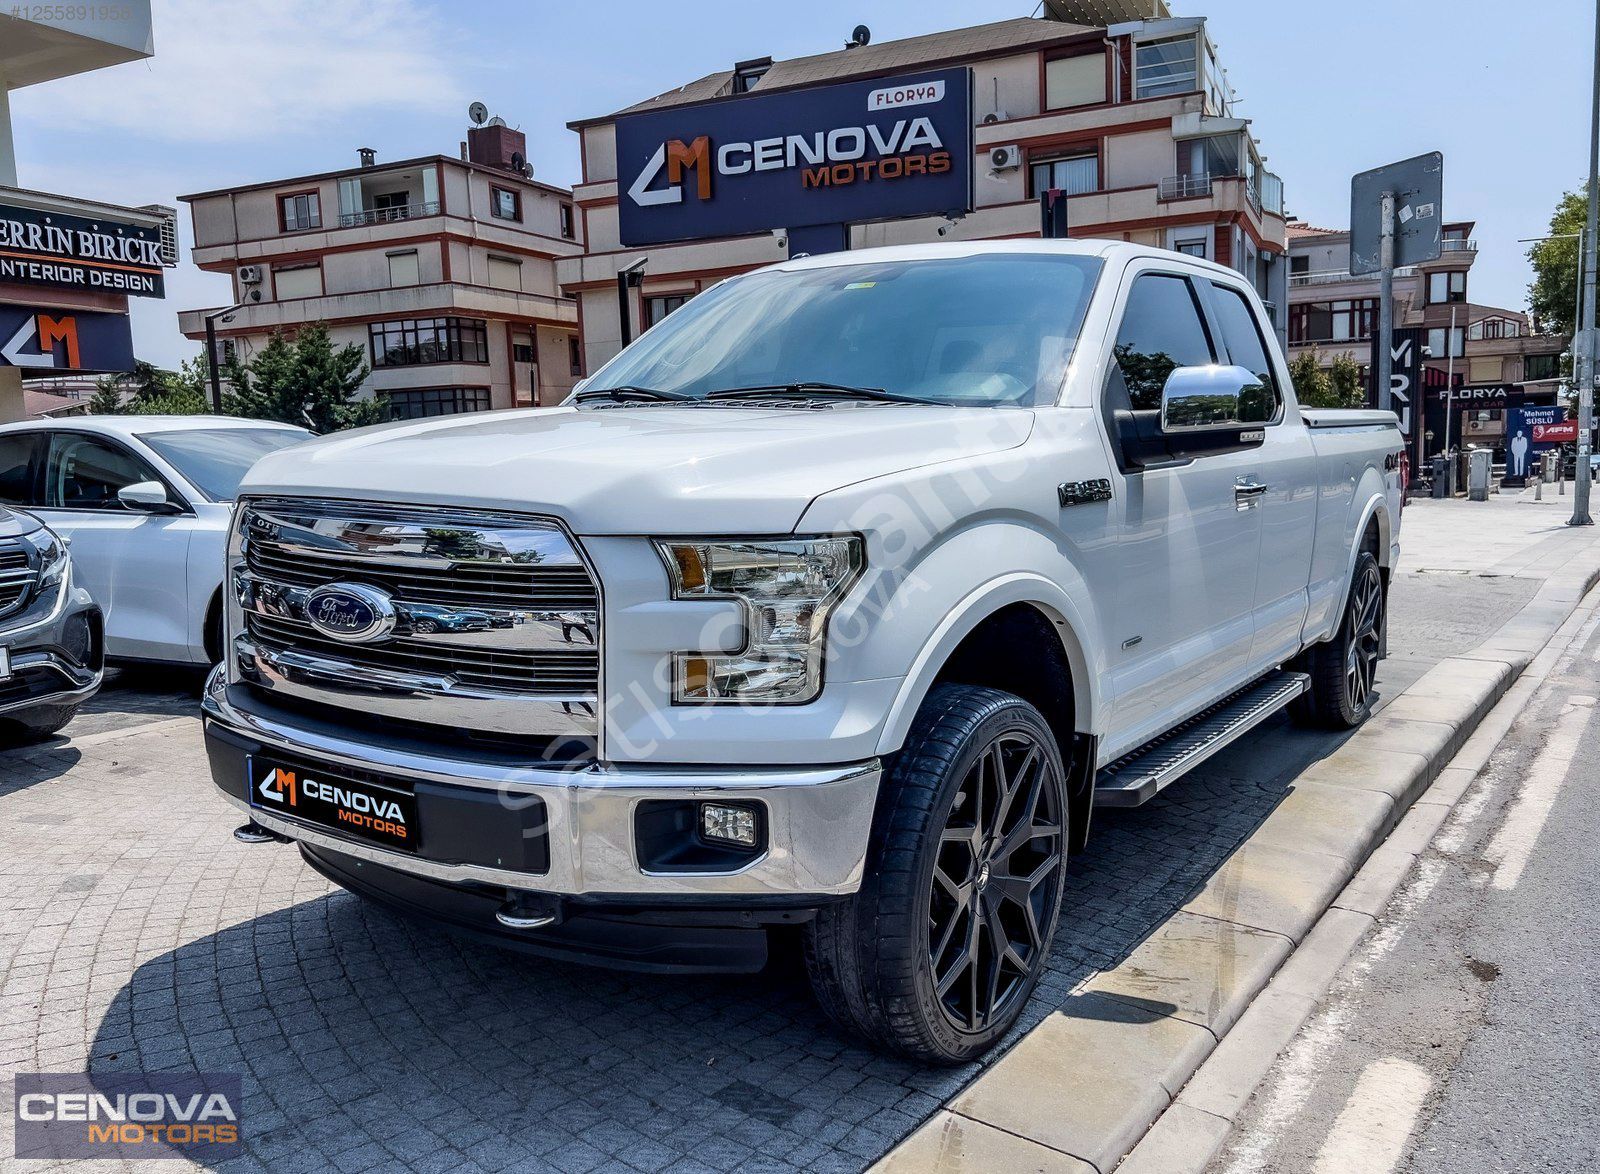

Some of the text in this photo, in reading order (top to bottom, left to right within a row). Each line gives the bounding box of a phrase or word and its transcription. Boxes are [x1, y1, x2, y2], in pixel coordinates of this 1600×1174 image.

[876, 86, 937, 106] FLORYA
[717, 117, 943, 176] CENOVA
[802, 152, 950, 189] MOTORS
[90, 269, 154, 292] DESIGN
[1439, 388, 1507, 400] FLORYA
[1524, 410, 1554, 418] Mehmet
[318, 597, 359, 627] Ford
[302, 779, 405, 823] CENOVA
[338, 809, 407, 838] MOTORS
